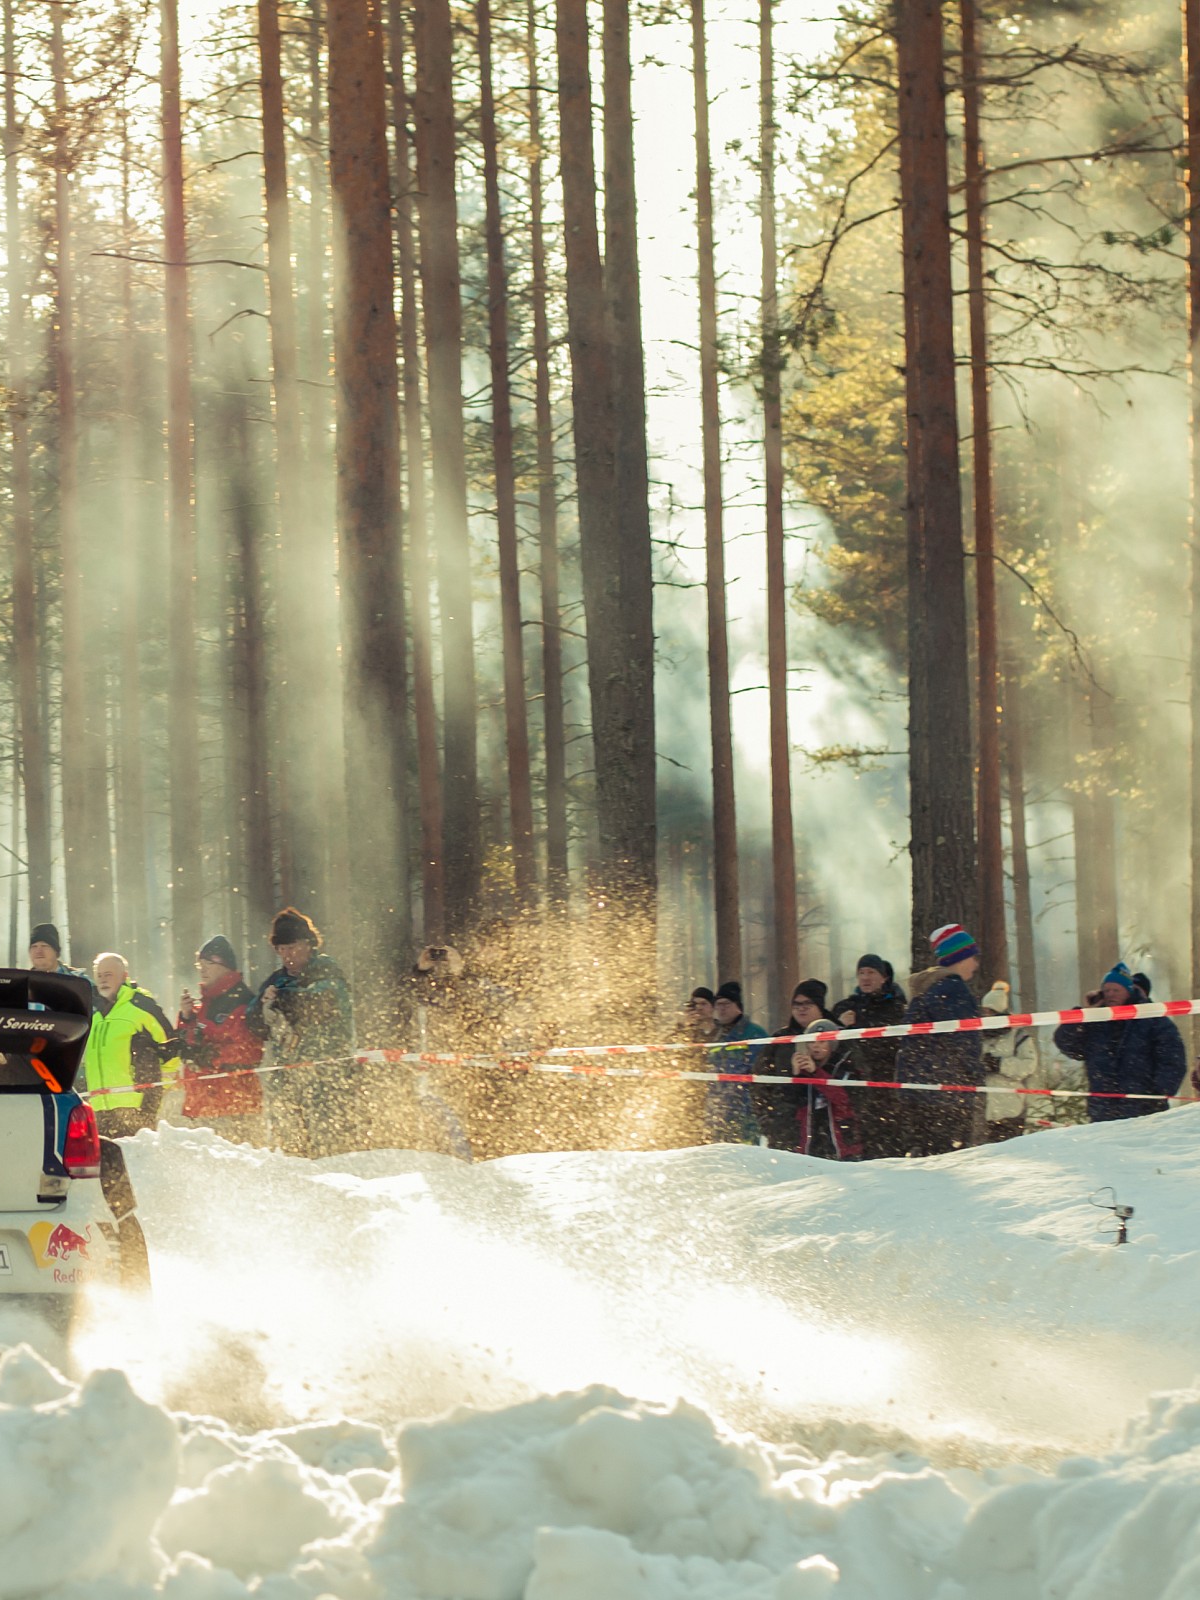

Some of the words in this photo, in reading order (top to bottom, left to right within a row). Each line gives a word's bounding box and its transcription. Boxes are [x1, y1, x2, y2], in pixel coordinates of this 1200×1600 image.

[3, 1017, 55, 1032] Services
[31, 1058, 62, 1093] 9
[53, 1268, 76, 1284] Red
